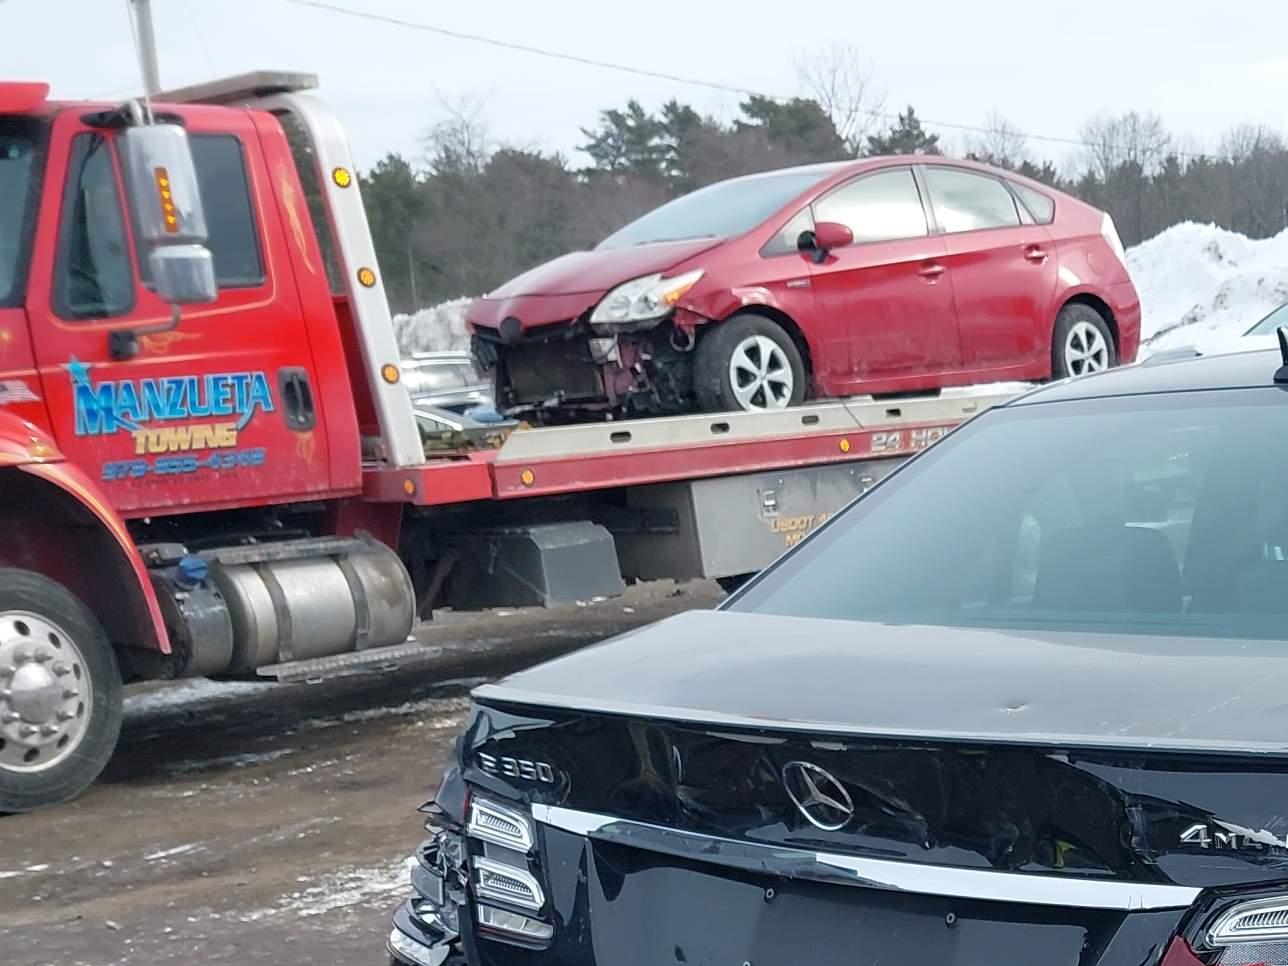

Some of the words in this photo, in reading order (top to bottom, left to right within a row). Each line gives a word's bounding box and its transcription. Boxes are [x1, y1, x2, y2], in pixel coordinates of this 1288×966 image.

[74, 371, 273, 434] MANZUETA
[132, 423, 238, 454] TOWING
[871, 431, 902, 453] 24
[478, 752, 498, 773] E
[500, 756, 554, 783] 350
